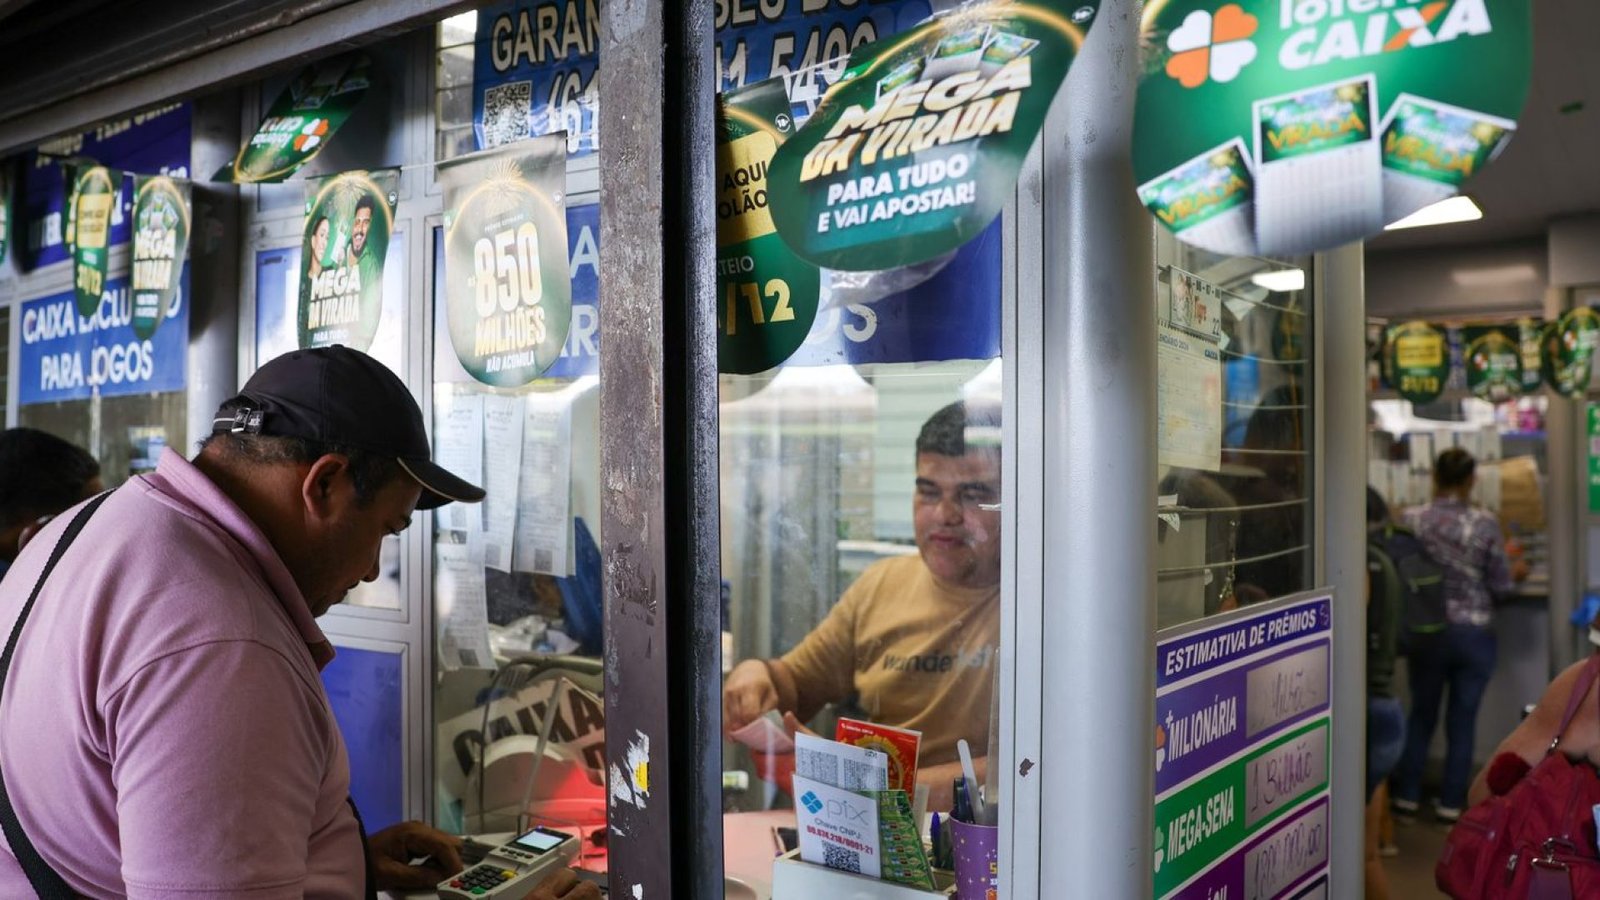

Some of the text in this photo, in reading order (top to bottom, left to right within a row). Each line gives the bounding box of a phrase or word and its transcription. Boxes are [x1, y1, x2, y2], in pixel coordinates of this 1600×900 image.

[1278, 0, 1493, 70] CAIXA
[824, 55, 1032, 139] MEGA
[800, 91, 1022, 182] DA VIRADA
[827, 153, 969, 206] PARA TUDO
[817, 181, 976, 233] E VAI APOSTAR!
[310, 264, 361, 301] MEGA
[474, 221, 543, 318] 850
[718, 255, 755, 277] TEIO
[23, 300, 76, 344] CAIXA
[474, 304, 547, 357] MILHÕES
[717, 278, 796, 336] /12
[40, 340, 154, 391] PARA JOGOS
[1165, 608, 1317, 676] ESTIMATIVA DE PRÊMIOS
[827, 799, 869, 826] pix
[1167, 785, 1235, 863] MEGA-SENA
